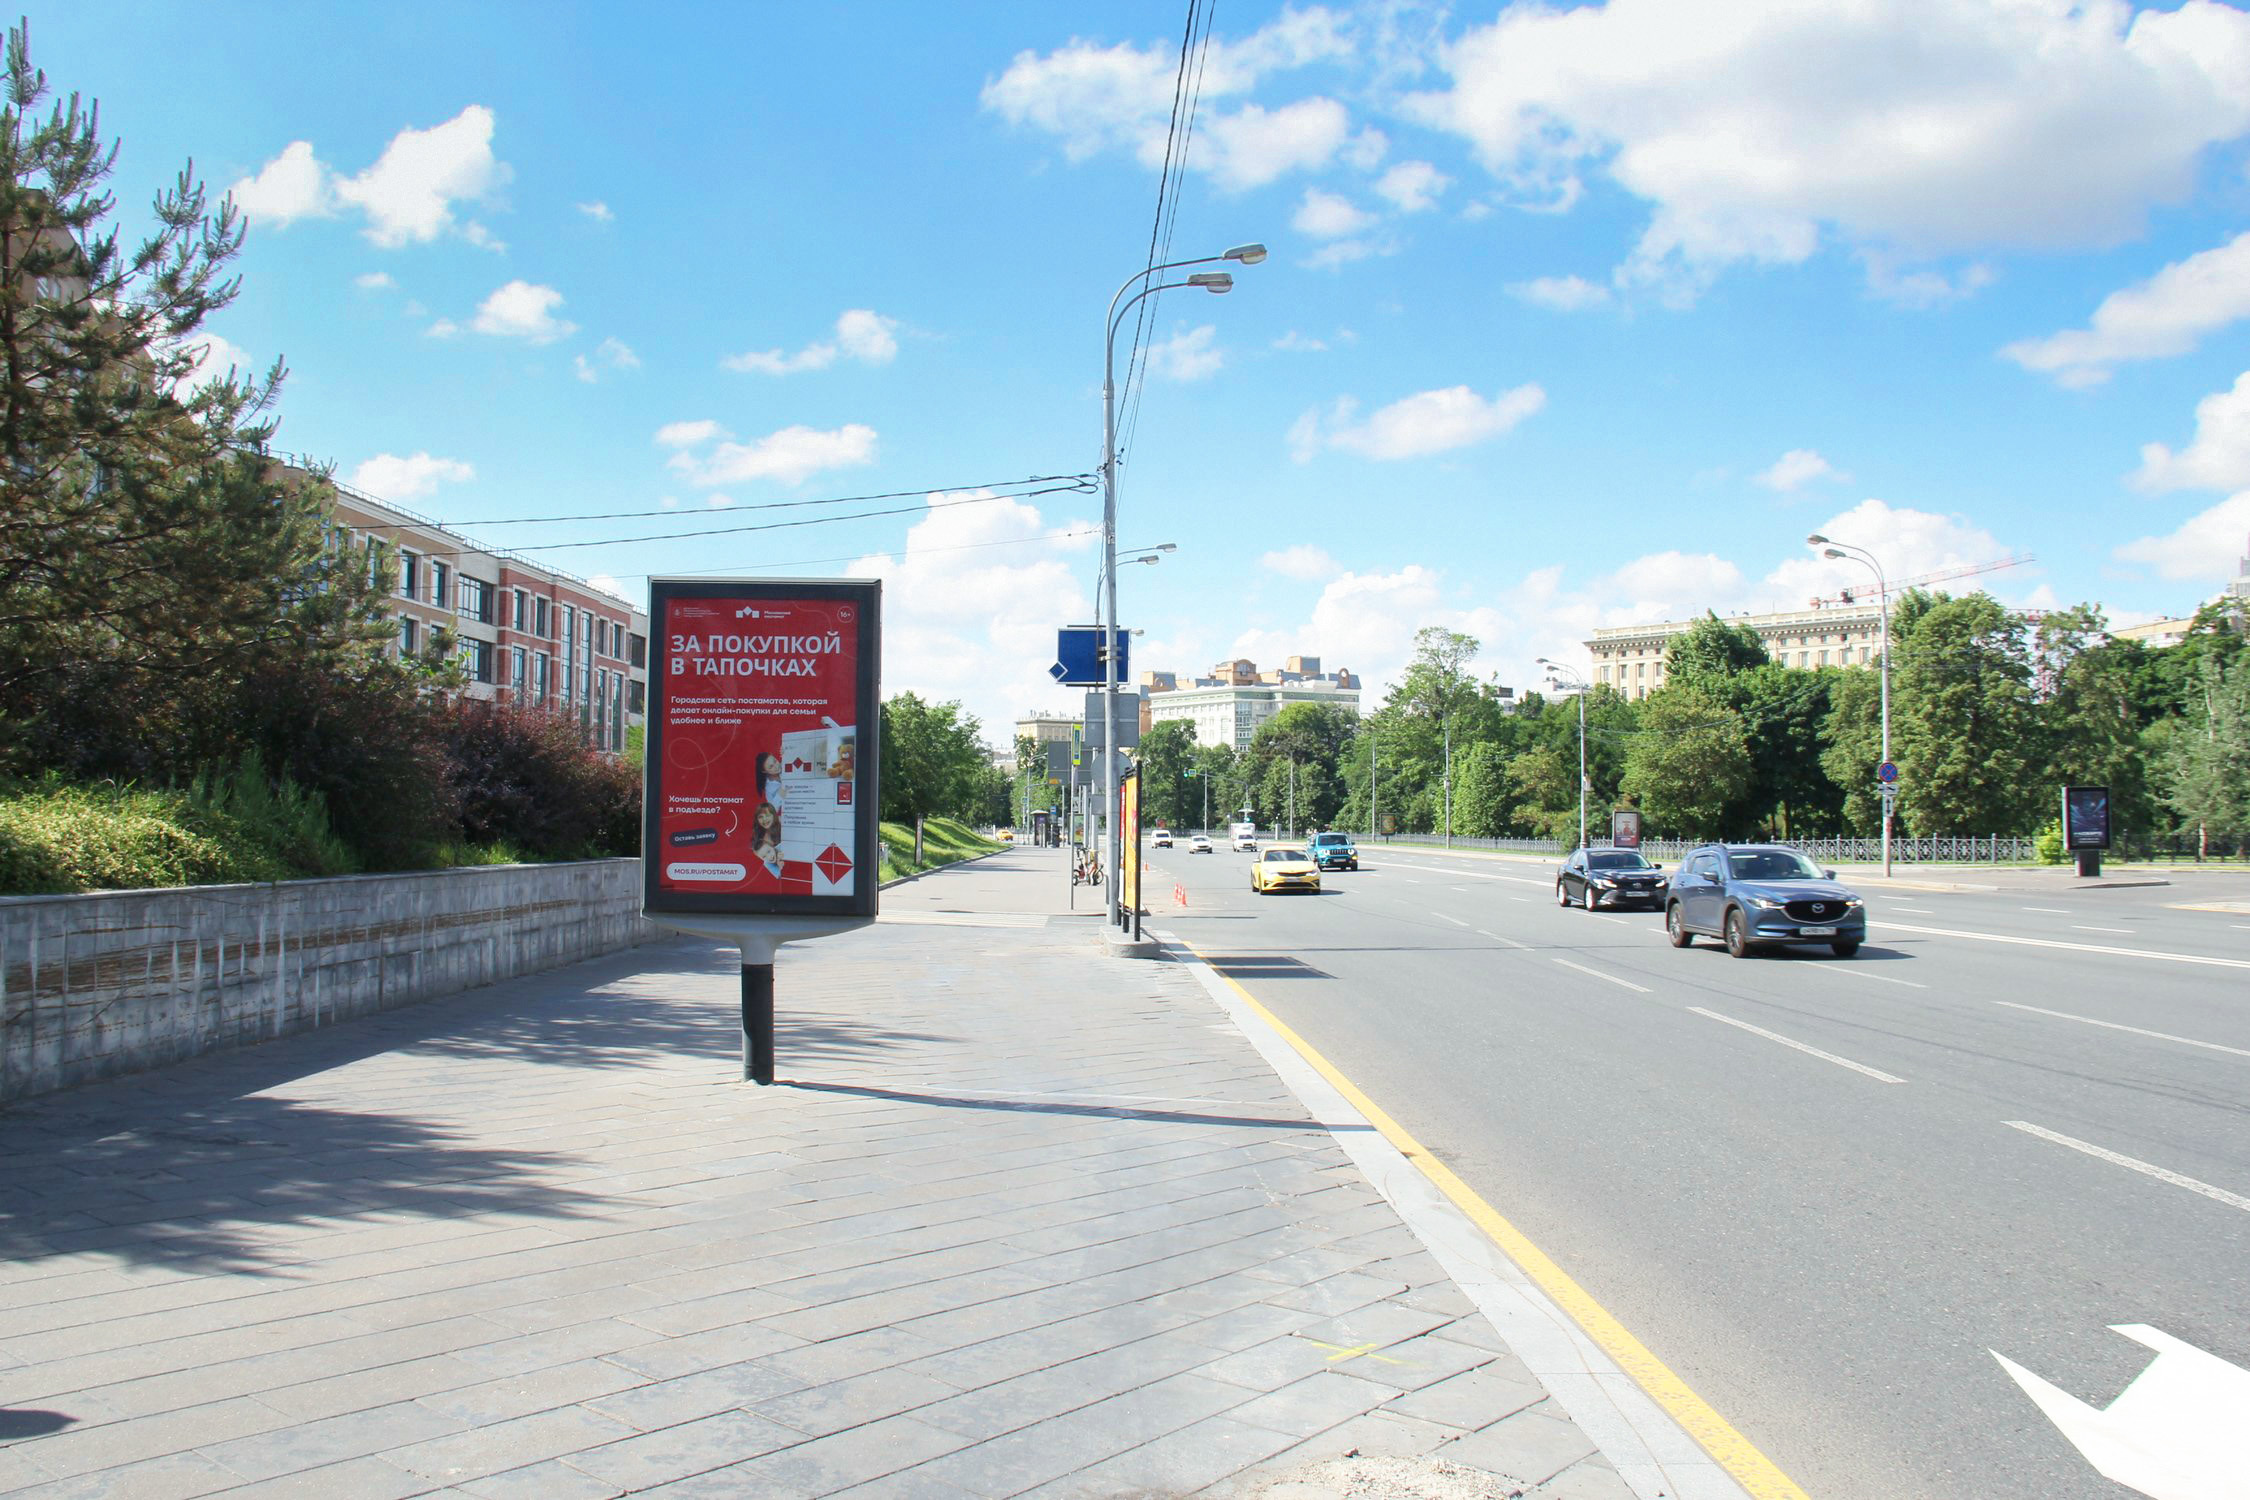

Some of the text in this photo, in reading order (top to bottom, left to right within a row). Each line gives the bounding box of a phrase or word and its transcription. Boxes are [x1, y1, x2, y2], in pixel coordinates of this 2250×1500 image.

[671, 631, 841, 654] ЗА ПОКУПКОЙ
[671, 657, 817, 677] В ТАПОЧКАХ
[671, 696, 716, 705] Городская
[738, 698, 791, 706] постаматов,
[792, 698, 828, 706] которая
[670, 707, 817, 716] делает онлайн-покупки для семьи
[670, 716, 706, 725] удобнее
[715, 716, 742, 725] ближе
[668, 795, 702, 804] Хочешь
[675, 806, 721, 814] подъезде?
